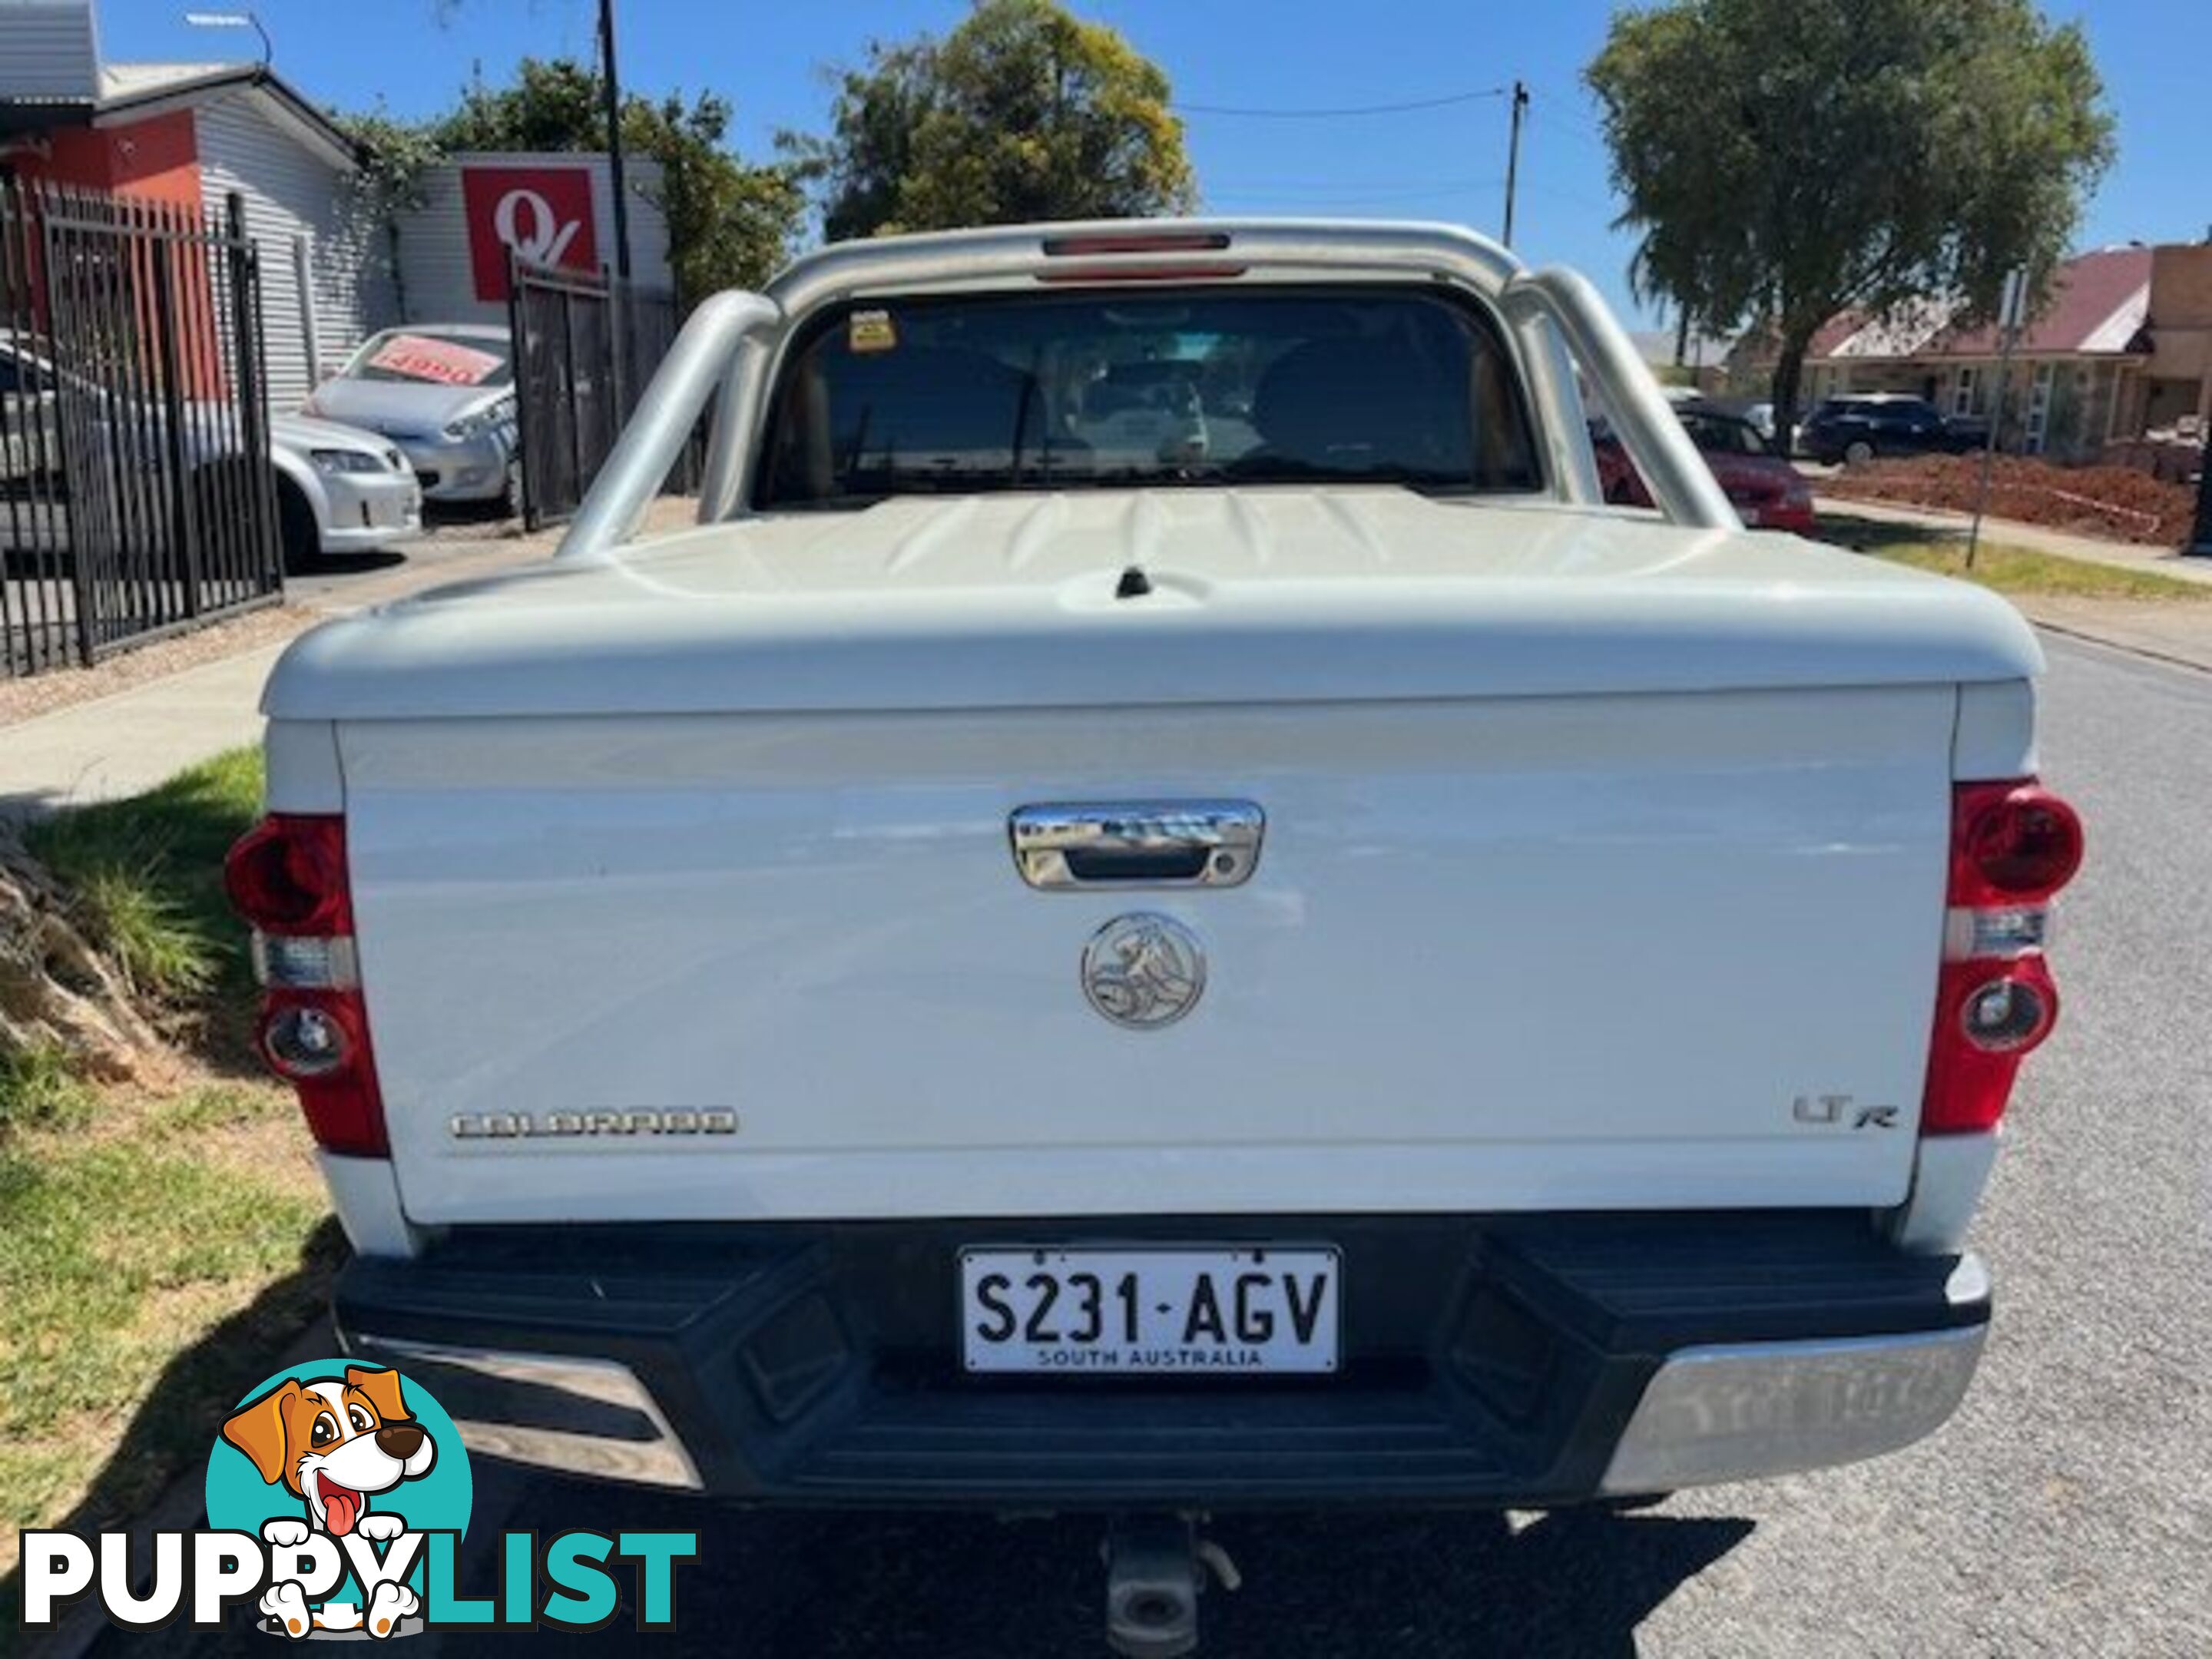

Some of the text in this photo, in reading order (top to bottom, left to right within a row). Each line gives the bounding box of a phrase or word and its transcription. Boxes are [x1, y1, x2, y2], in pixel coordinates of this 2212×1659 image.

[451, 1109, 737, 1139] COLORADO
[1038, 1349, 1263, 1366] SOUTH AUSTRALIA
